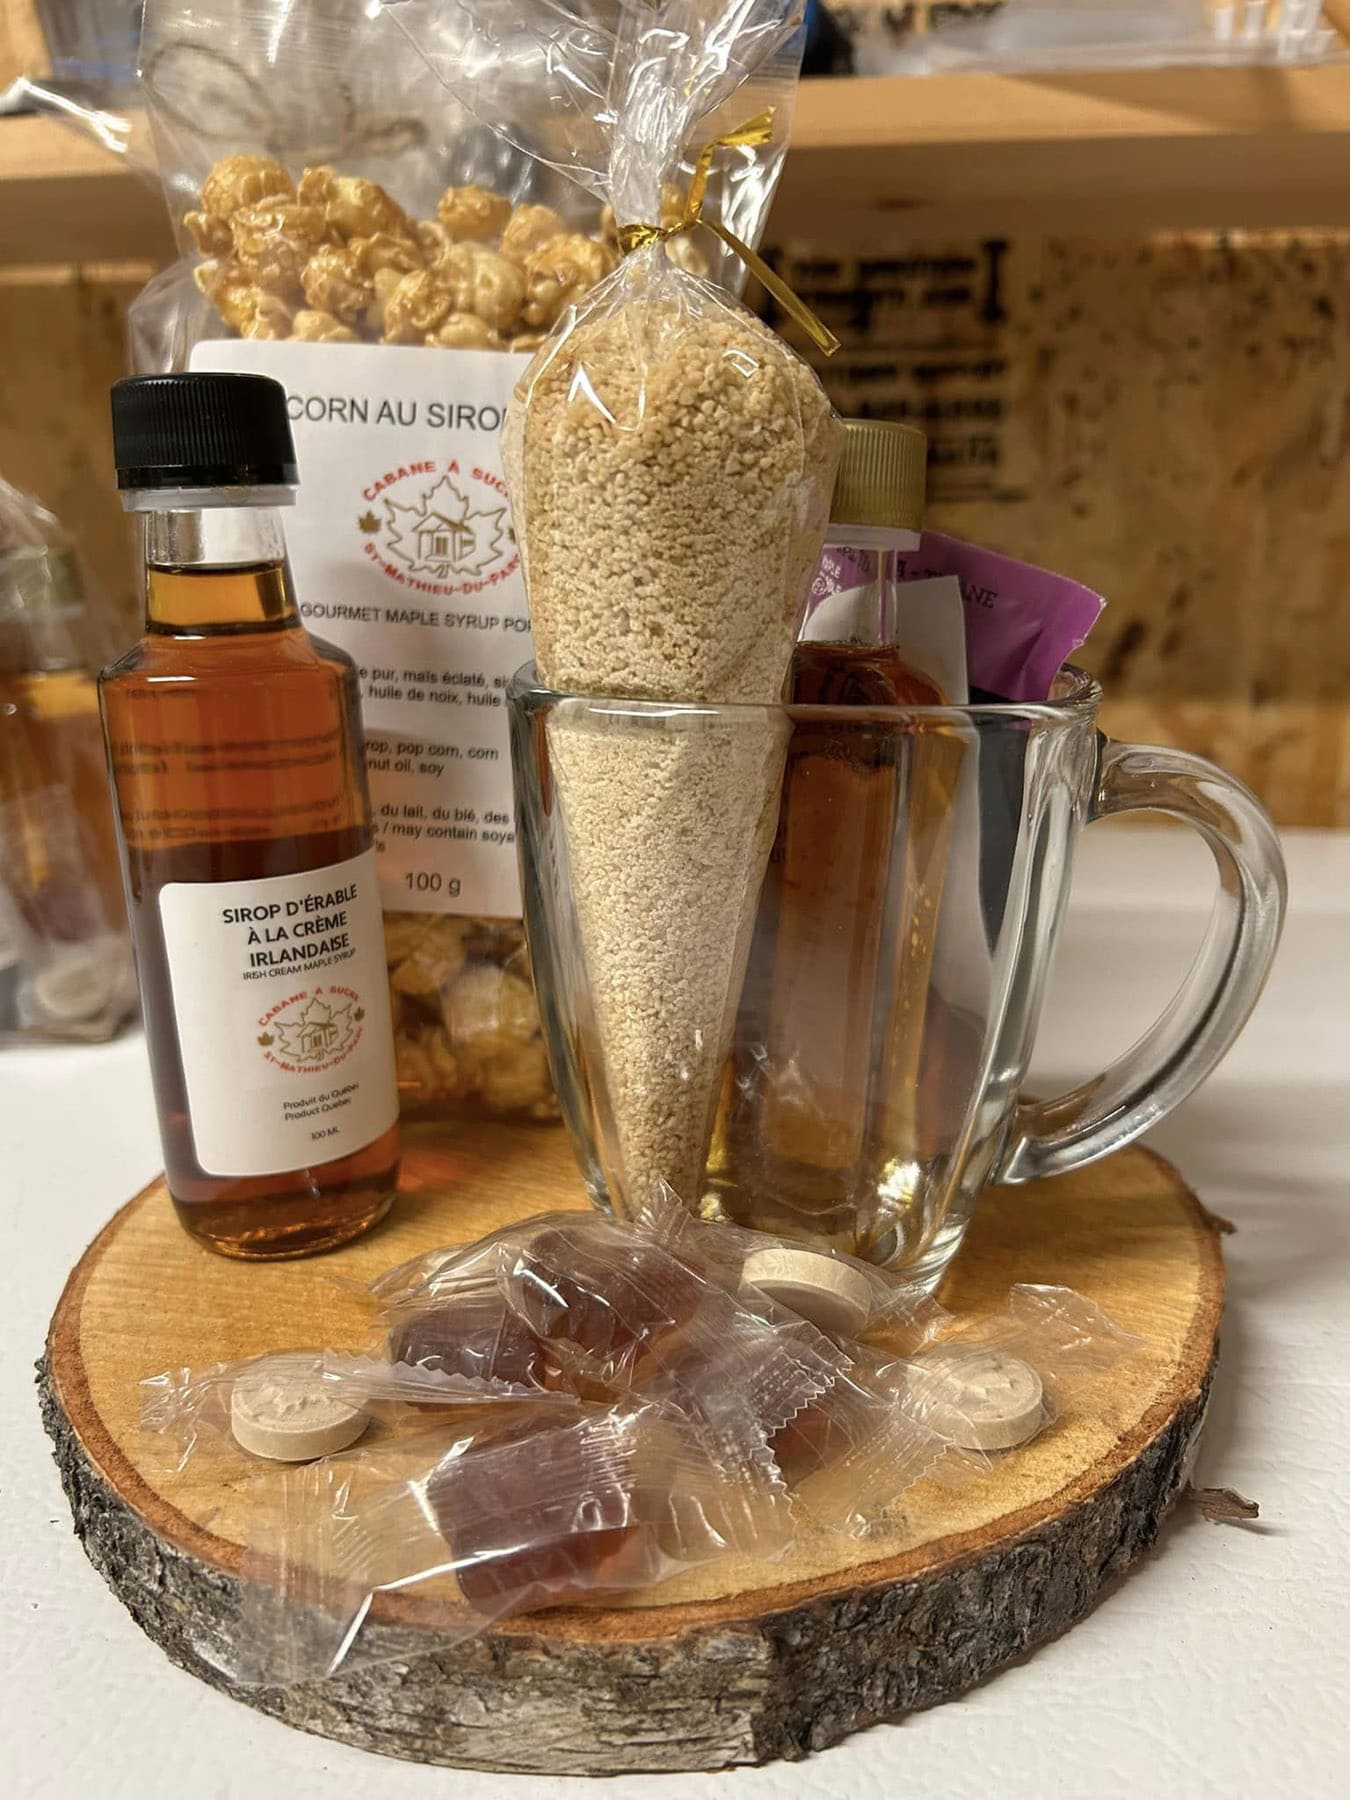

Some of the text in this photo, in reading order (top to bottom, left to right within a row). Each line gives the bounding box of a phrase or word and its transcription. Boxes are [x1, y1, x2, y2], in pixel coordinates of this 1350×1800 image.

[376, 400, 417, 426] AU
[363, 460, 435, 501] CABANE
[472, 468, 509, 497] SUC
[364, 542, 521, 595] ST-MATHIEU-DU-PAR
[300, 603, 382, 622] GOURMET
[385, 608, 441, 627] MAPLE
[444, 613, 500, 630] SYRUP
[369, 684, 402, 700] huile
[408, 688, 425, 702] de
[430, 689, 462, 706] noix,
[467, 691, 501, 707] huile
[397, 742, 424, 757] pop
[468, 747, 499, 761] corn
[420, 762, 445, 778] soy
[381, 803, 399, 817] du
[432, 807, 449, 821] du
[484, 811, 509, 825] des
[392, 825, 422, 840] may
[427, 826, 477, 841] contain
[406, 872, 461, 898] 100 g
[223, 884, 358, 923] SIROP D'ÉRABLE
[248, 911, 347, 945] À LA CRÈME
[250, 933, 350, 967] IRLANDAISE
[243, 969, 266, 980] IRISH
[269, 965, 302, 978] CREAM
[304, 959, 332, 972] MAPLE
[283, 1096, 317, 1110] Produit
[319, 1093, 330, 1102] du
[284, 1107, 320, 1121] Product
